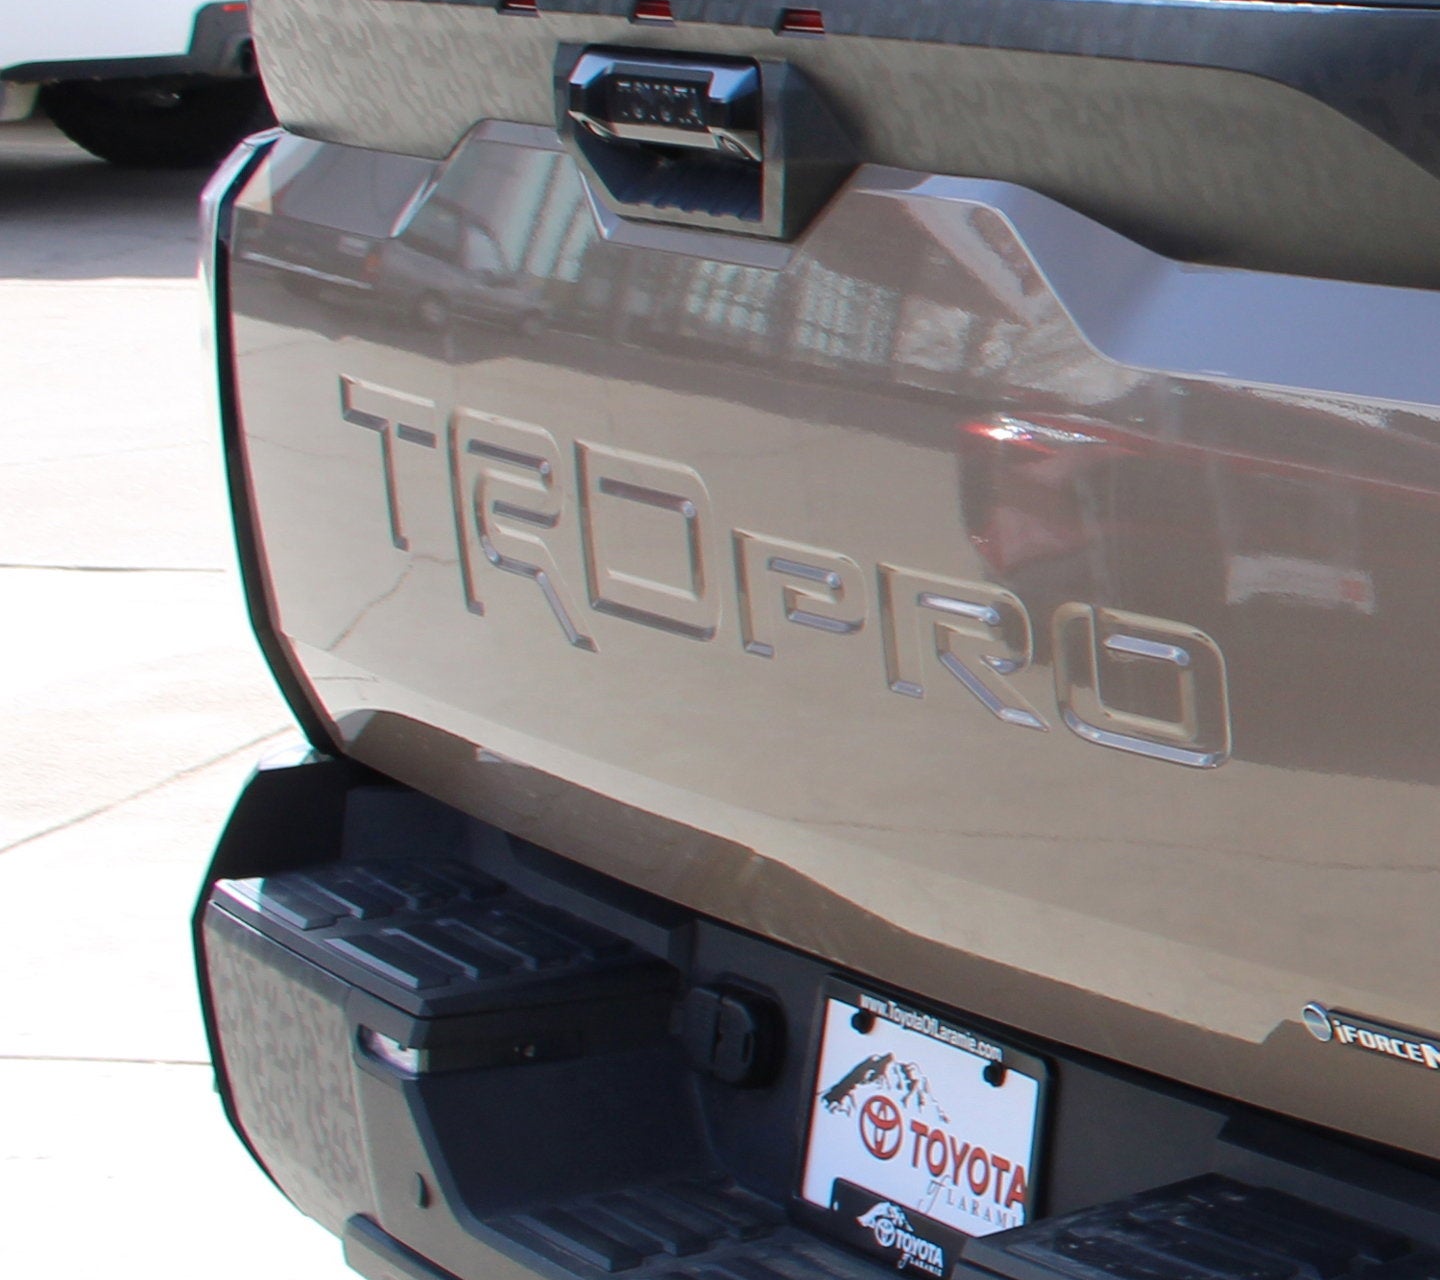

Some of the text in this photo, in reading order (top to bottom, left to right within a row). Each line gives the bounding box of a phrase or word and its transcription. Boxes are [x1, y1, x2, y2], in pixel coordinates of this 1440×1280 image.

[338, 372, 1233, 770] TRD PRO
[910, 1120, 1028, 1209] TOYOTA
[945, 1188, 1022, 1229] LARAMI
[896, 1228, 943, 1268] TOYOTA
